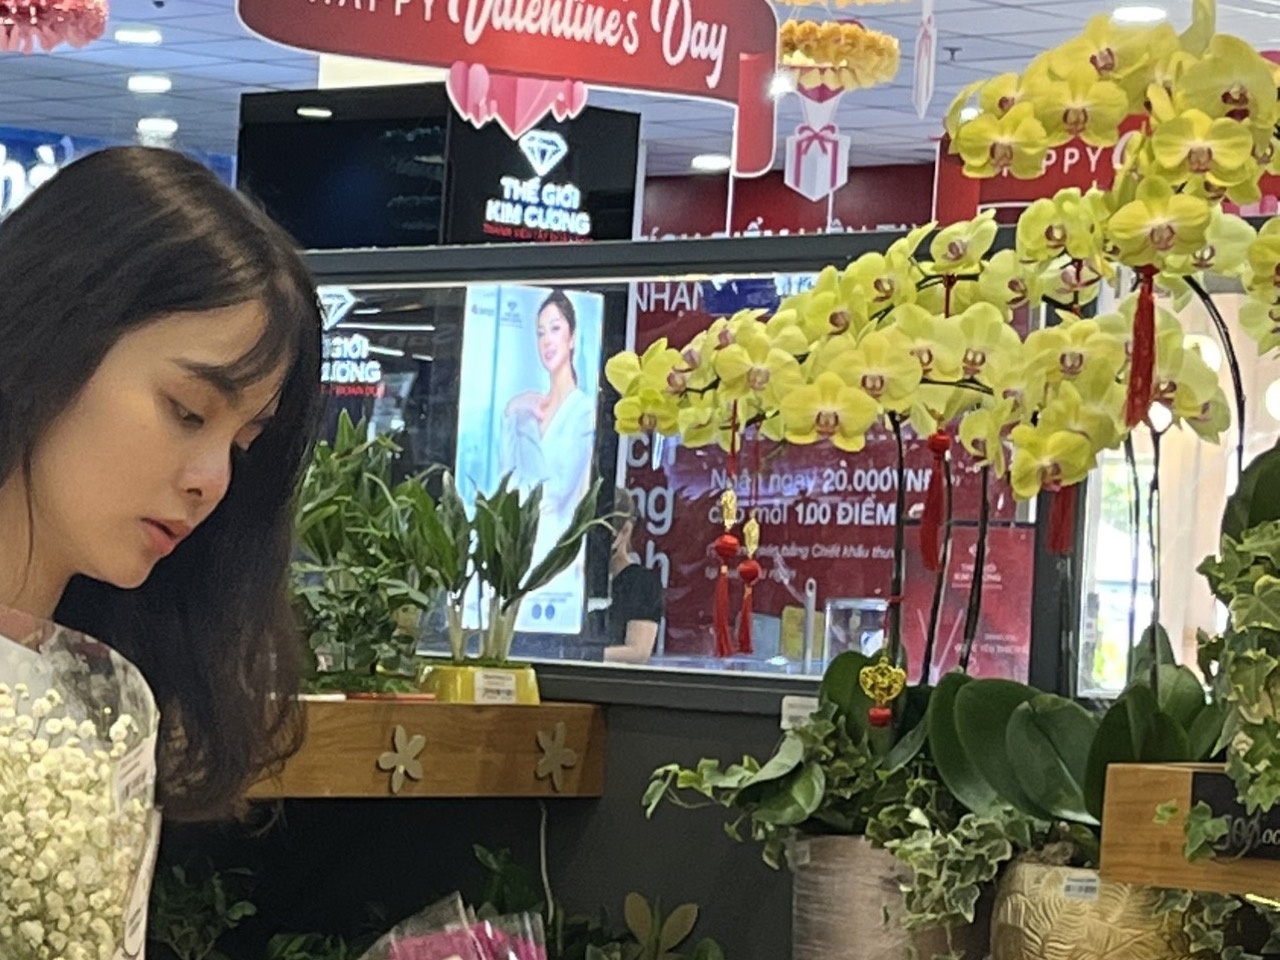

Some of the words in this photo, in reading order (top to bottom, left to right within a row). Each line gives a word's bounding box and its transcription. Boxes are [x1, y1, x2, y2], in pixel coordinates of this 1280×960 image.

[448, 0, 640, 55] Valentines
[650, 0, 728, 89] Day
[822, 467, 931, 492] 20.000VN
[708, 506, 745, 524] co
[795, 502, 831, 525] 100
[836, 494, 897, 526] ĐIỂM
